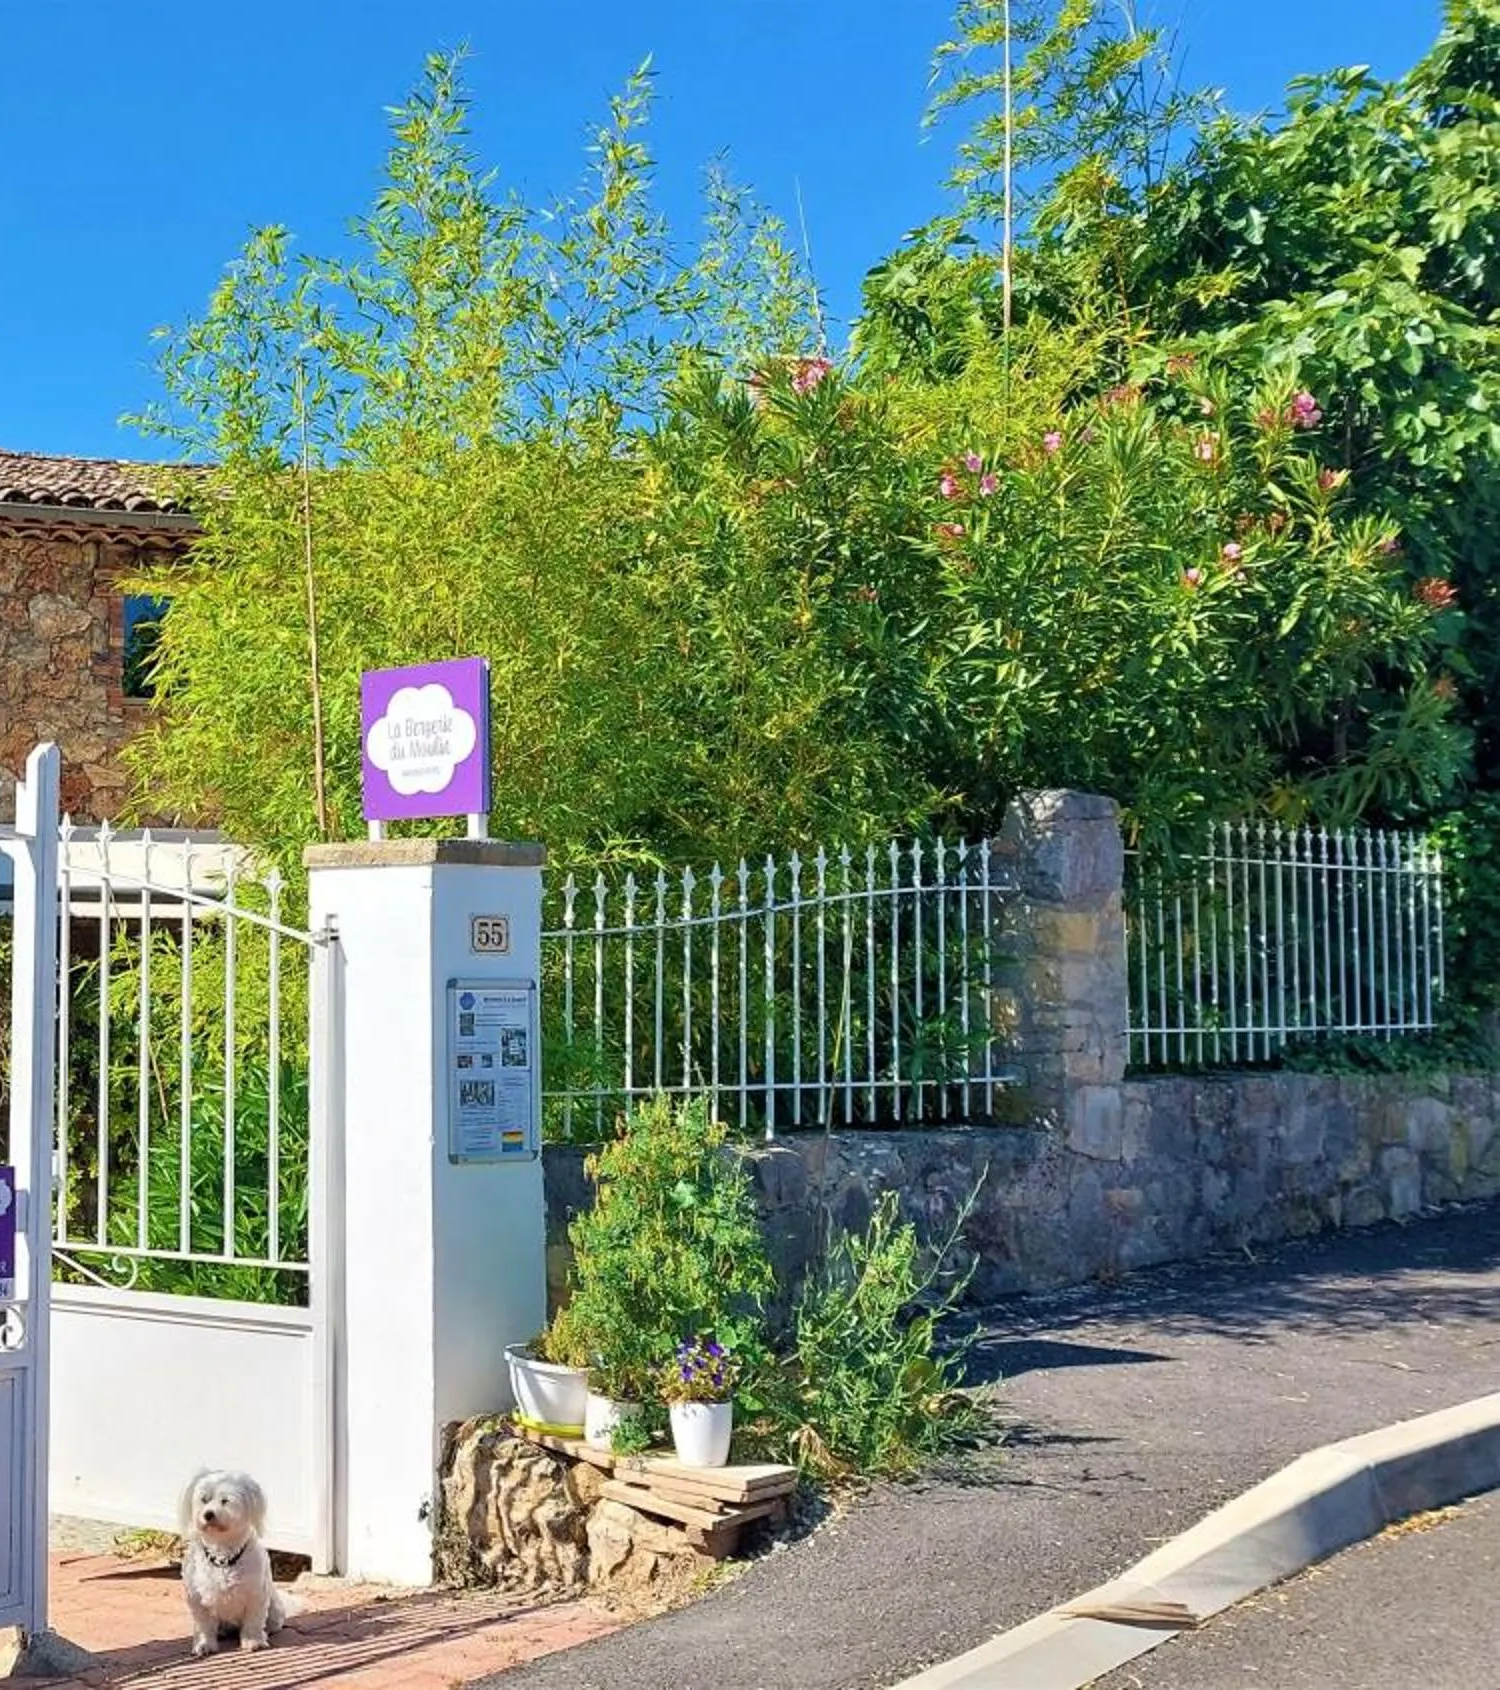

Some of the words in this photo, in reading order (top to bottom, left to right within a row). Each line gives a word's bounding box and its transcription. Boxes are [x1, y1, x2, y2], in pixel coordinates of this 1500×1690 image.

[388, 722, 401, 739] La
[405, 712, 452, 739] Bergerie
[390, 742, 405, 761] du
[409, 737, 451, 759] Moulin
[478, 921, 503, 947] 55
